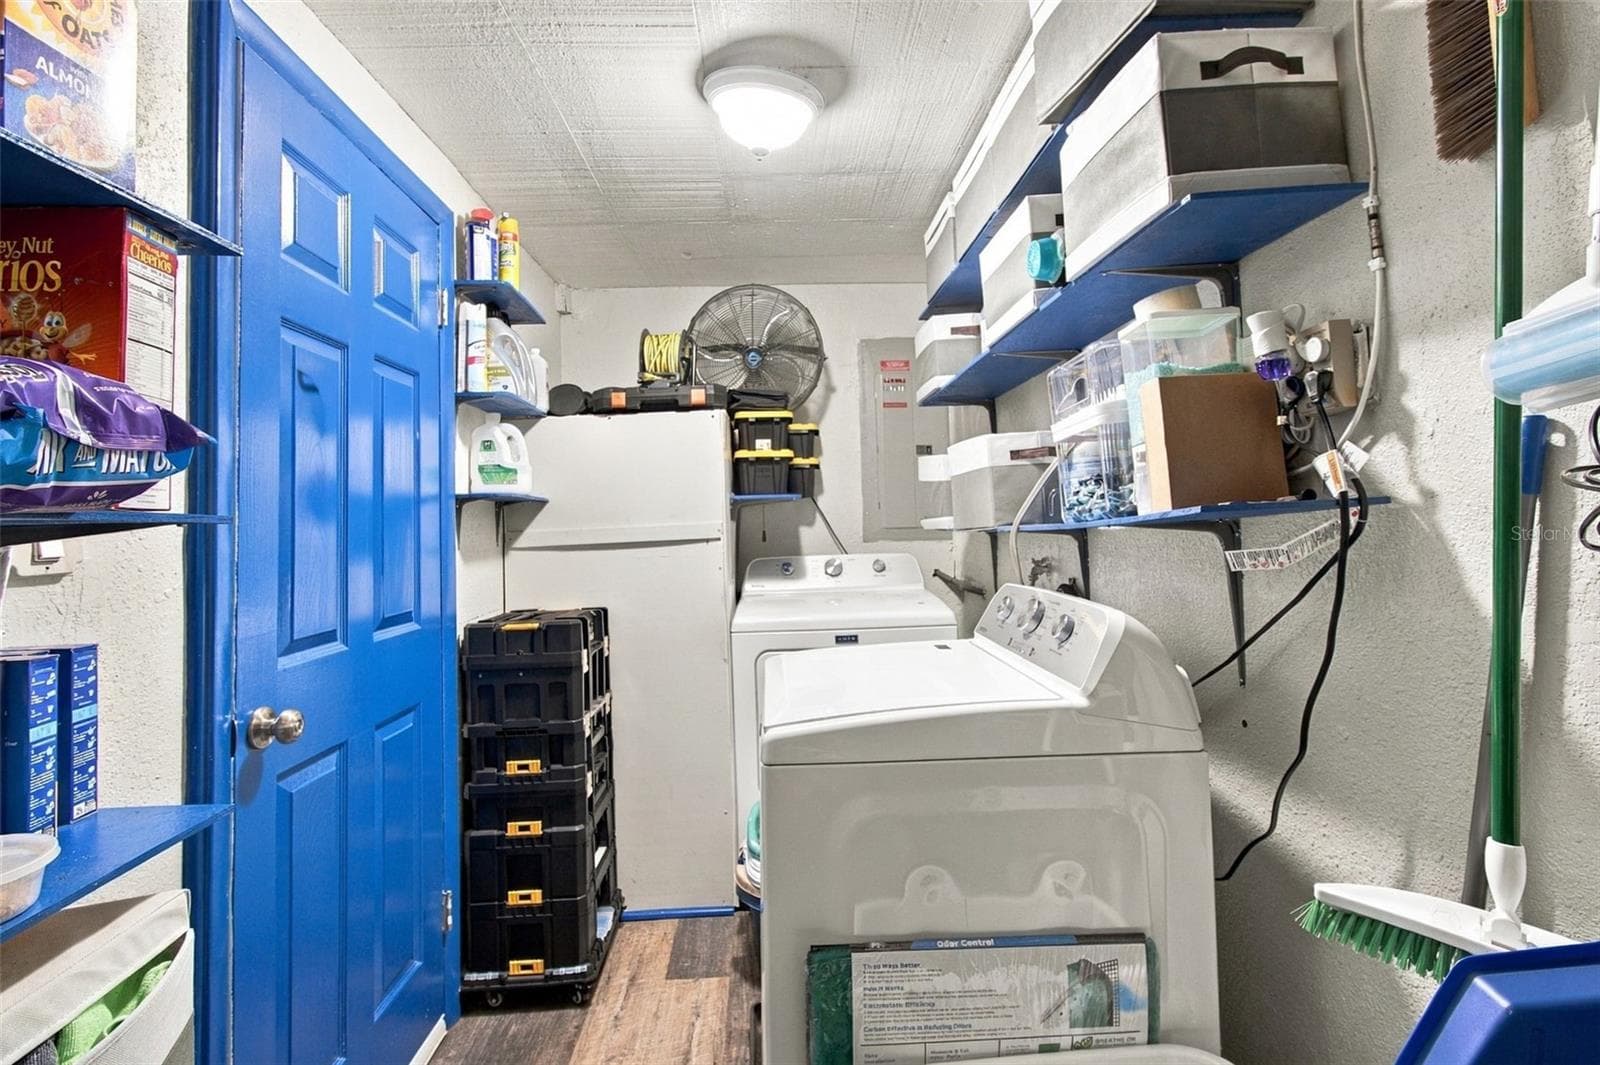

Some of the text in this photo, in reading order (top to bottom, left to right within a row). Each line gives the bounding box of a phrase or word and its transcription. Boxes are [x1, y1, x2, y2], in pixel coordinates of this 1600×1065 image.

[22, 236, 54, 254] Nut
[130, 242, 172, 274] Cheerios
[0, 260, 61, 292] rios
[960, 938, 995, 947] Control
